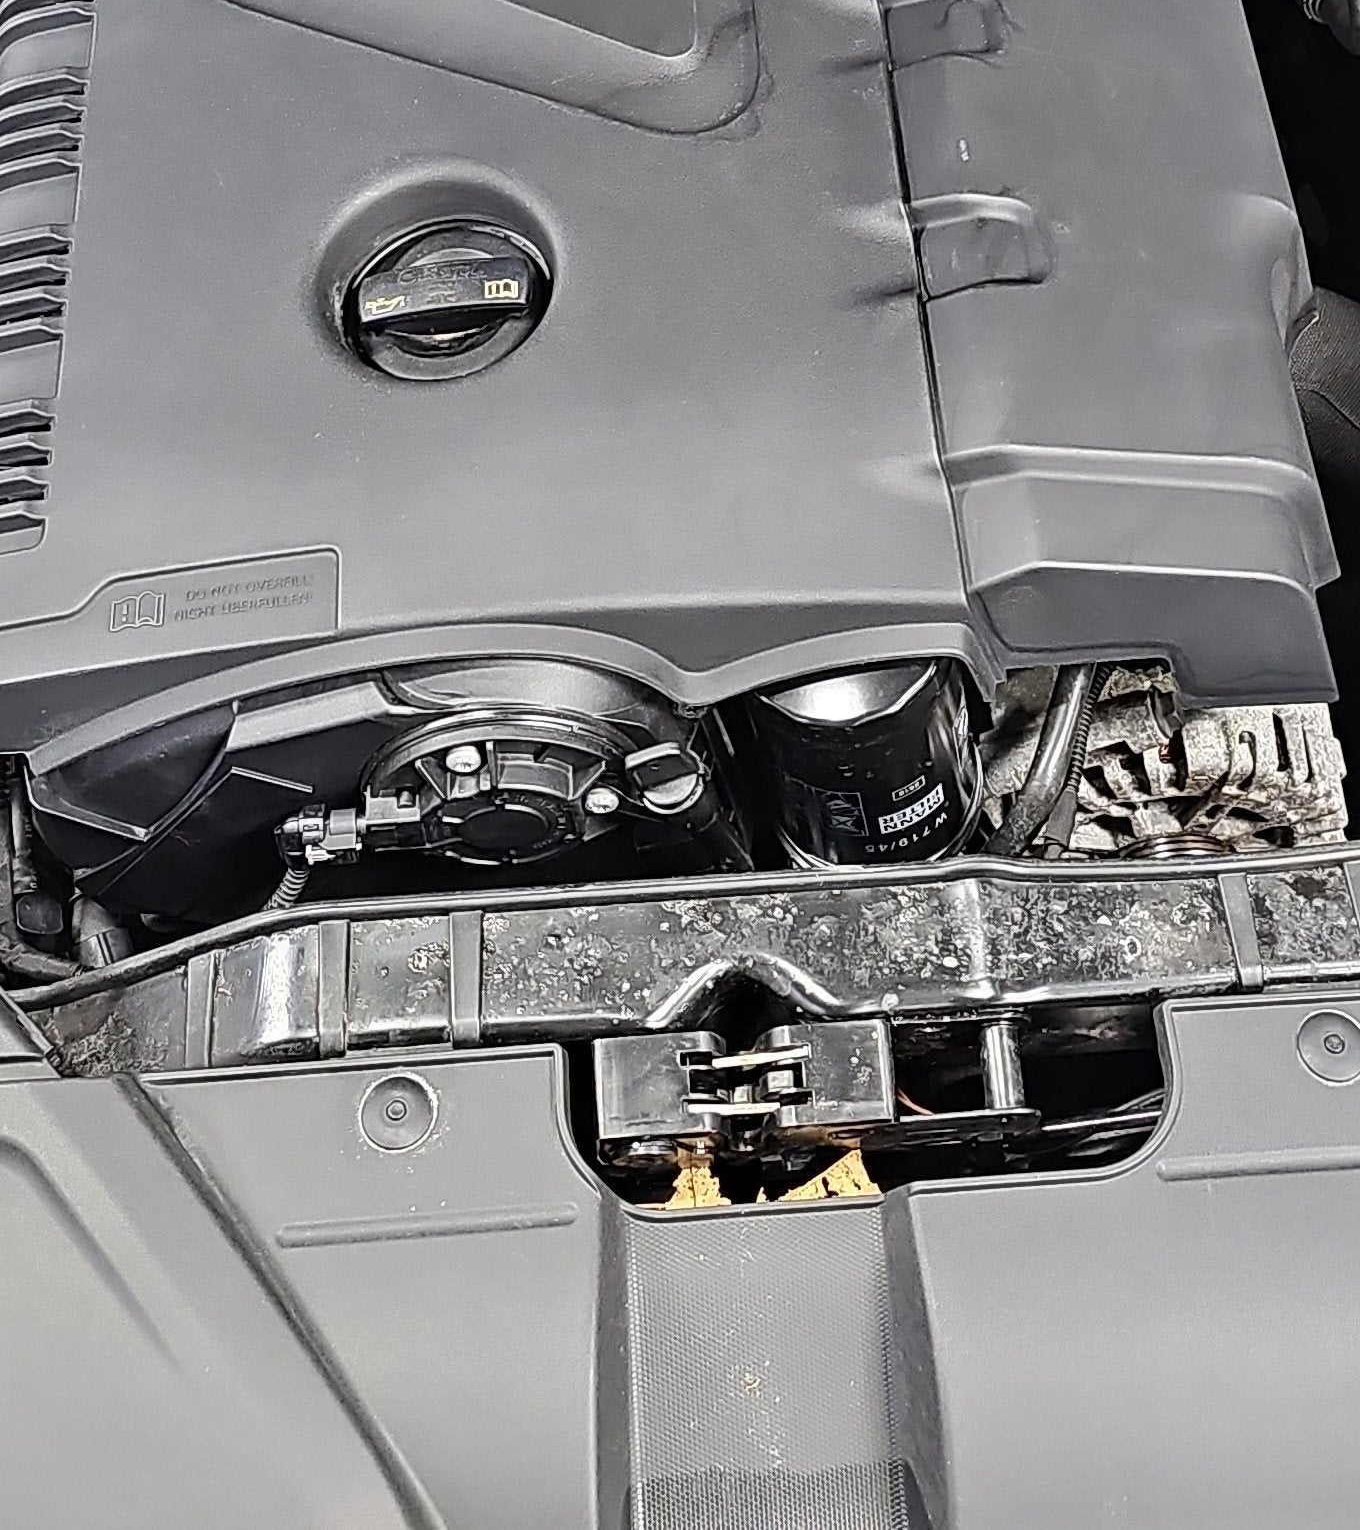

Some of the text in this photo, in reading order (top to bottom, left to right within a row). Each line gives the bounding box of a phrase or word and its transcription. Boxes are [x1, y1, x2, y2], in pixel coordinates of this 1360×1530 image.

[882, 788, 940, 825] FILTER
[883, 797, 941, 832] MANN
[935, 812, 947, 828] W
